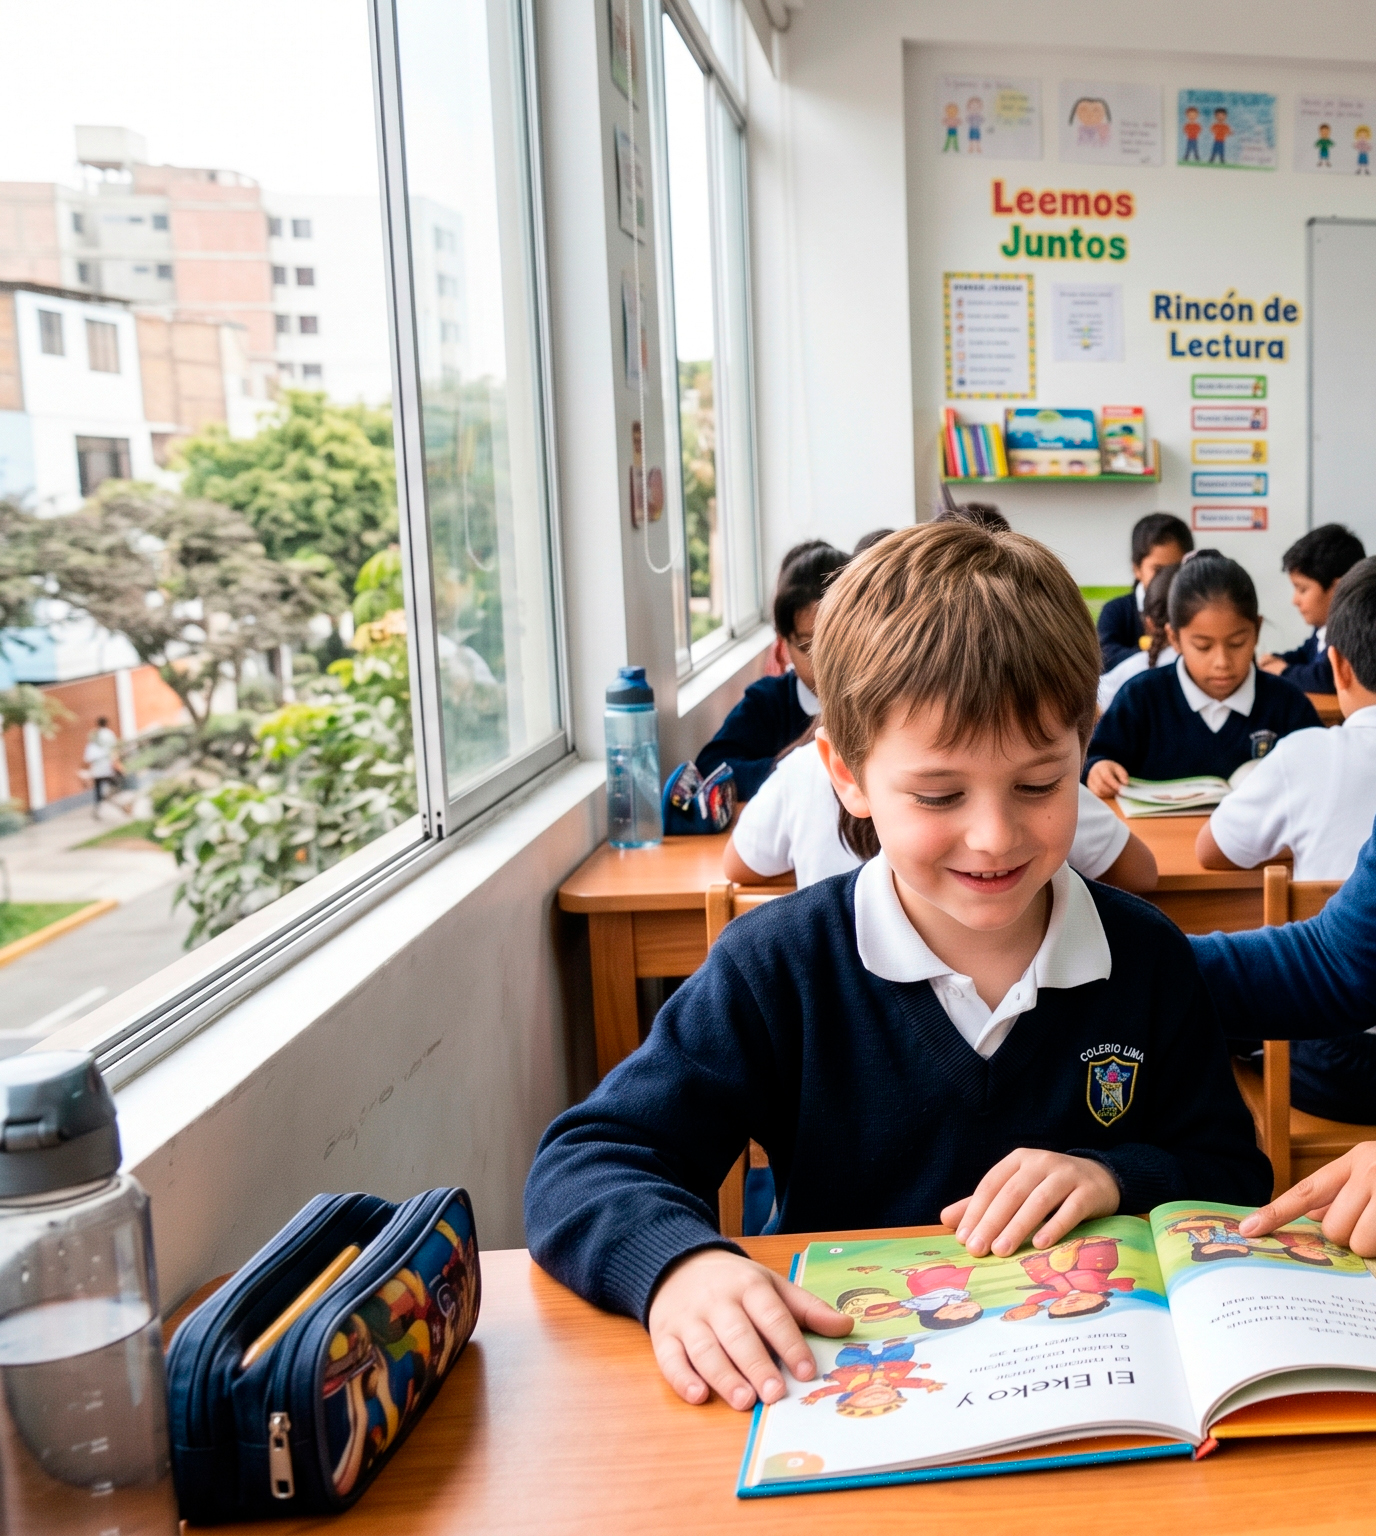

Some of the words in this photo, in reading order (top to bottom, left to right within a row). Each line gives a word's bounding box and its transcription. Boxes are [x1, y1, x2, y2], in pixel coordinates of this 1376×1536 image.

[993, 181, 1134, 217] Leemos
[1001, 225, 1127, 260] Juntos
[1153, 291, 1254, 322] Rincón
[1264, 296, 1299, 323] de
[1170, 332, 1285, 360] Lectura
[1123, 1045, 1144, 1063] LIMA
[988, 1373, 1092, 1401] Ekeko
[1106, 1370, 1135, 1385] El
[955, 1391, 974, 1409] y
